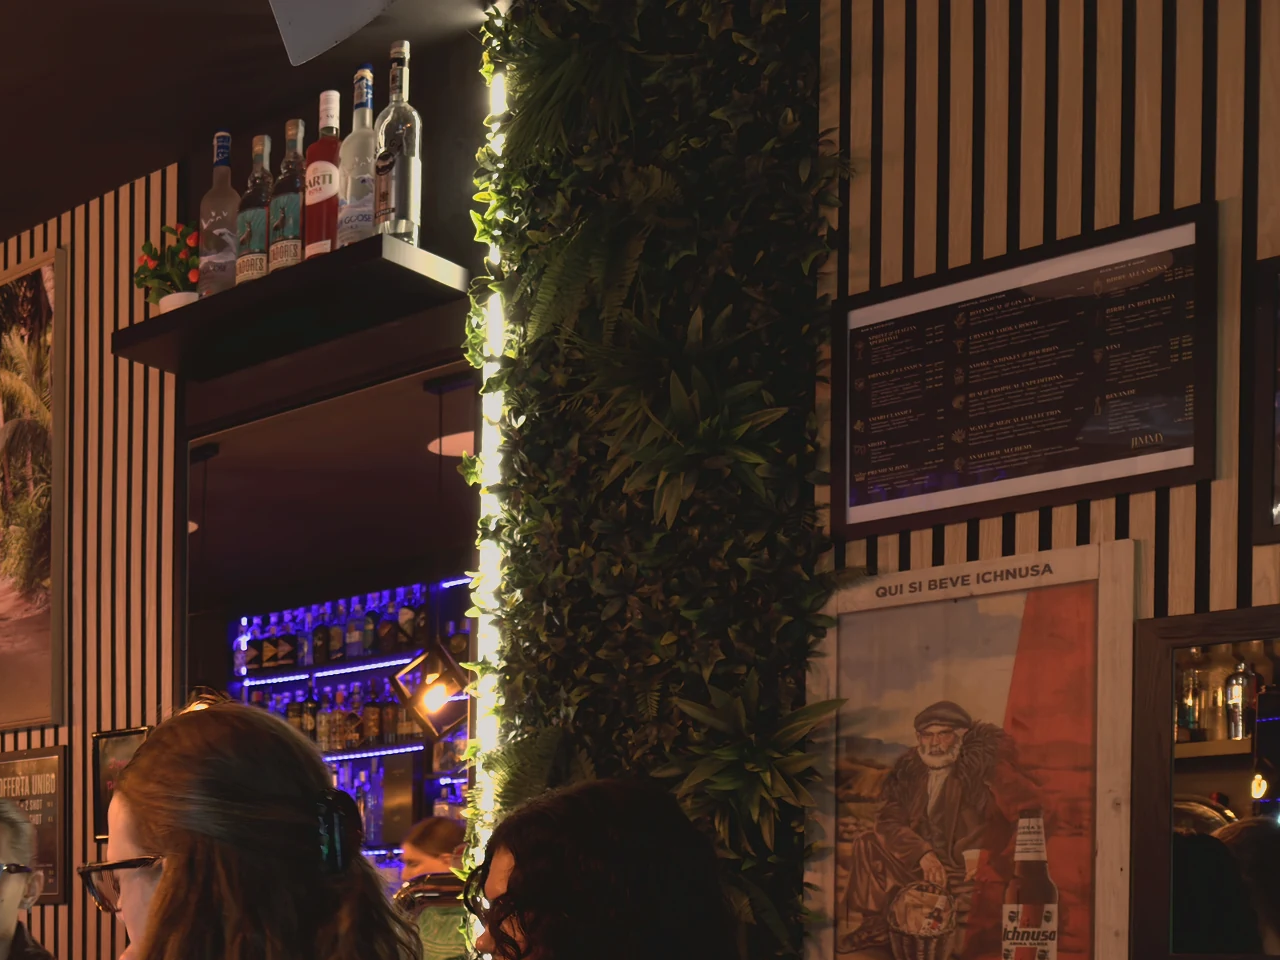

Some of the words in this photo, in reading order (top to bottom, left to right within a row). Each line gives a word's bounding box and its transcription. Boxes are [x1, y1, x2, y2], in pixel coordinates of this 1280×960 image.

[1131, 431, 1164, 449] JIMMY
[875, 582, 904, 599] QUI
[908, 580, 923, 595] SI
[927, 574, 971, 592] BEVE
[976, 563, 1053, 586] ICHNUSA
[31, 772, 56, 795] UNIBO
[29, 799, 43, 811] SHOT
[1003, 924, 1057, 942] ichnusa
